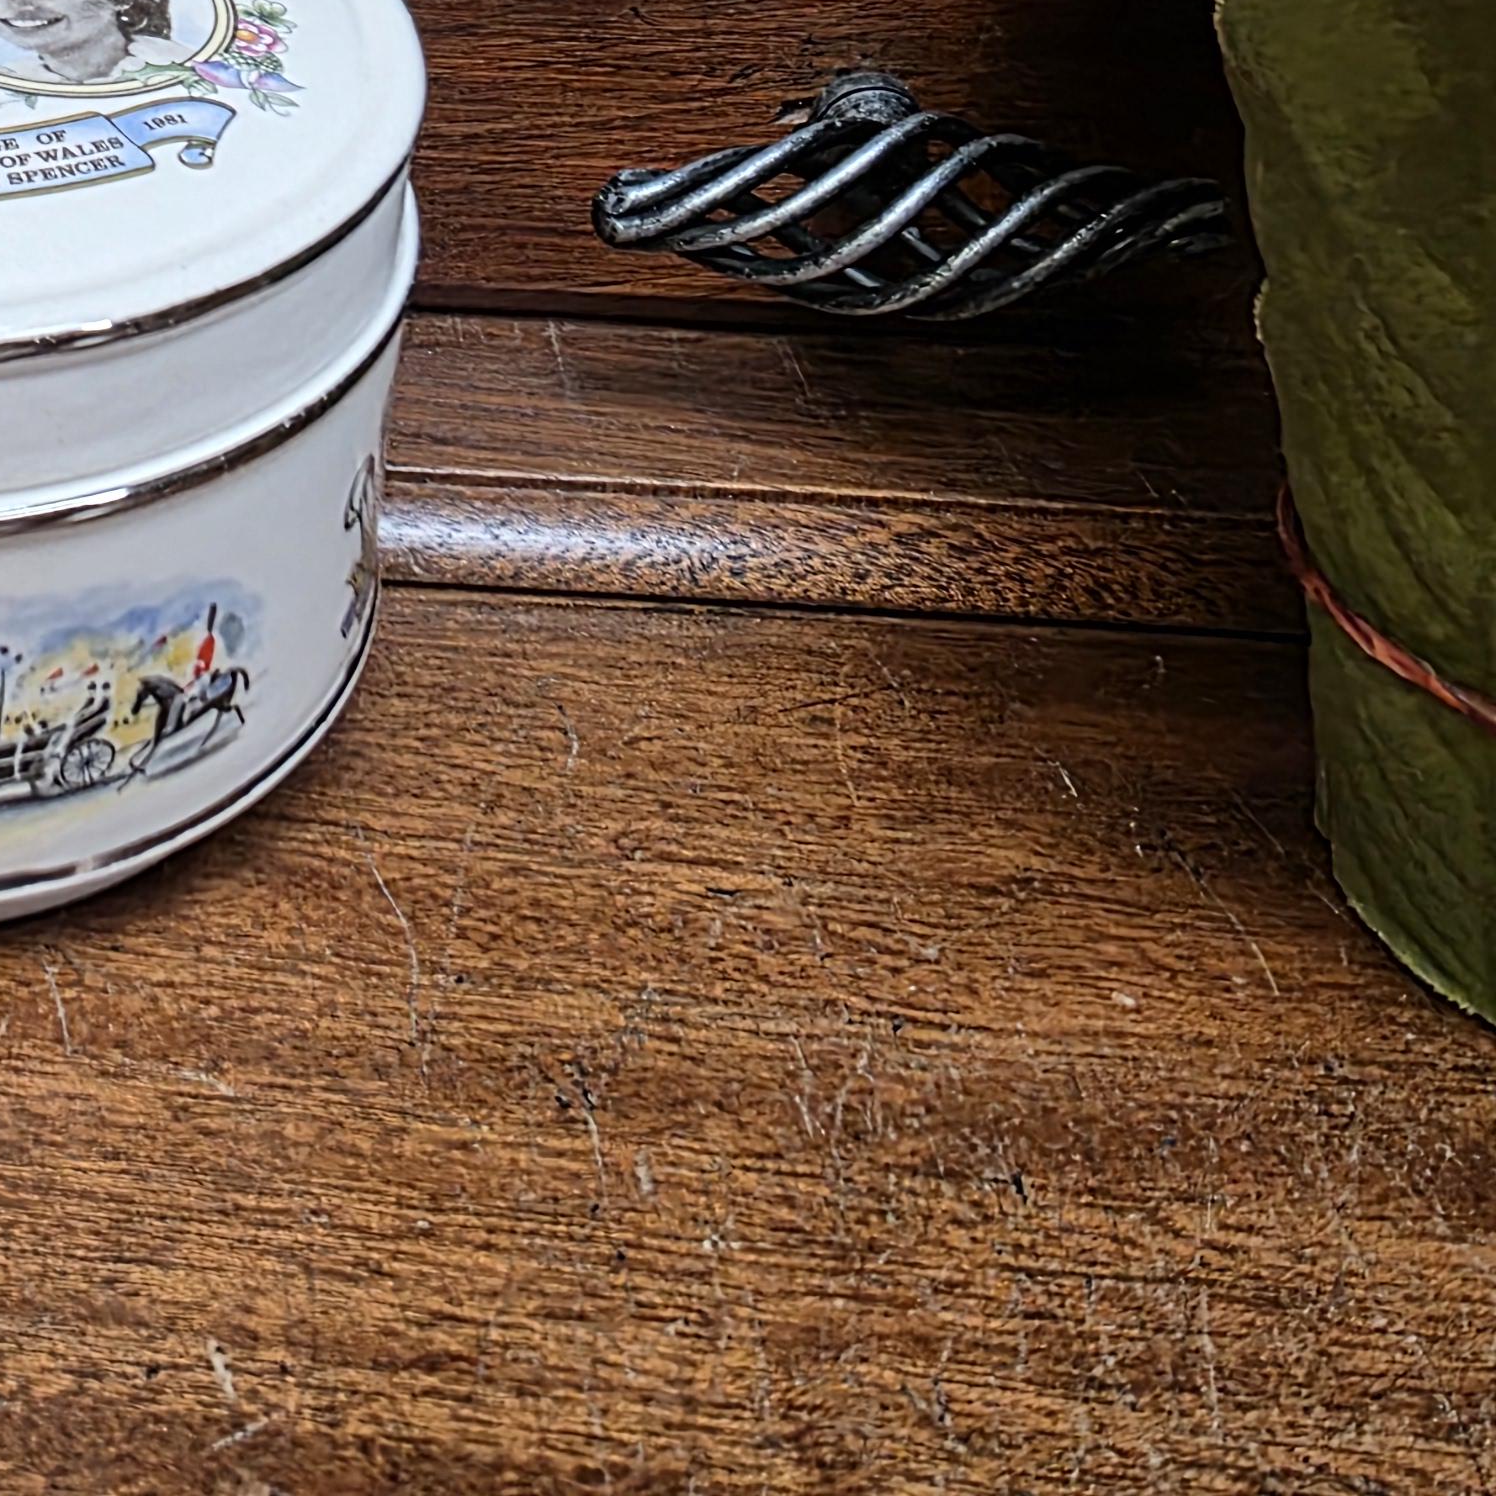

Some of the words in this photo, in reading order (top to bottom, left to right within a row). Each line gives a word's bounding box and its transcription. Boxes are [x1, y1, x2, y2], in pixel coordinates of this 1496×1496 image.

[142, 112, 189, 131] 1981
[35, 129, 68, 146] OF
[0, 154, 31, 169] OF
[33, 136, 125, 163] WALES
[7, 154, 127, 186] SPENCER
